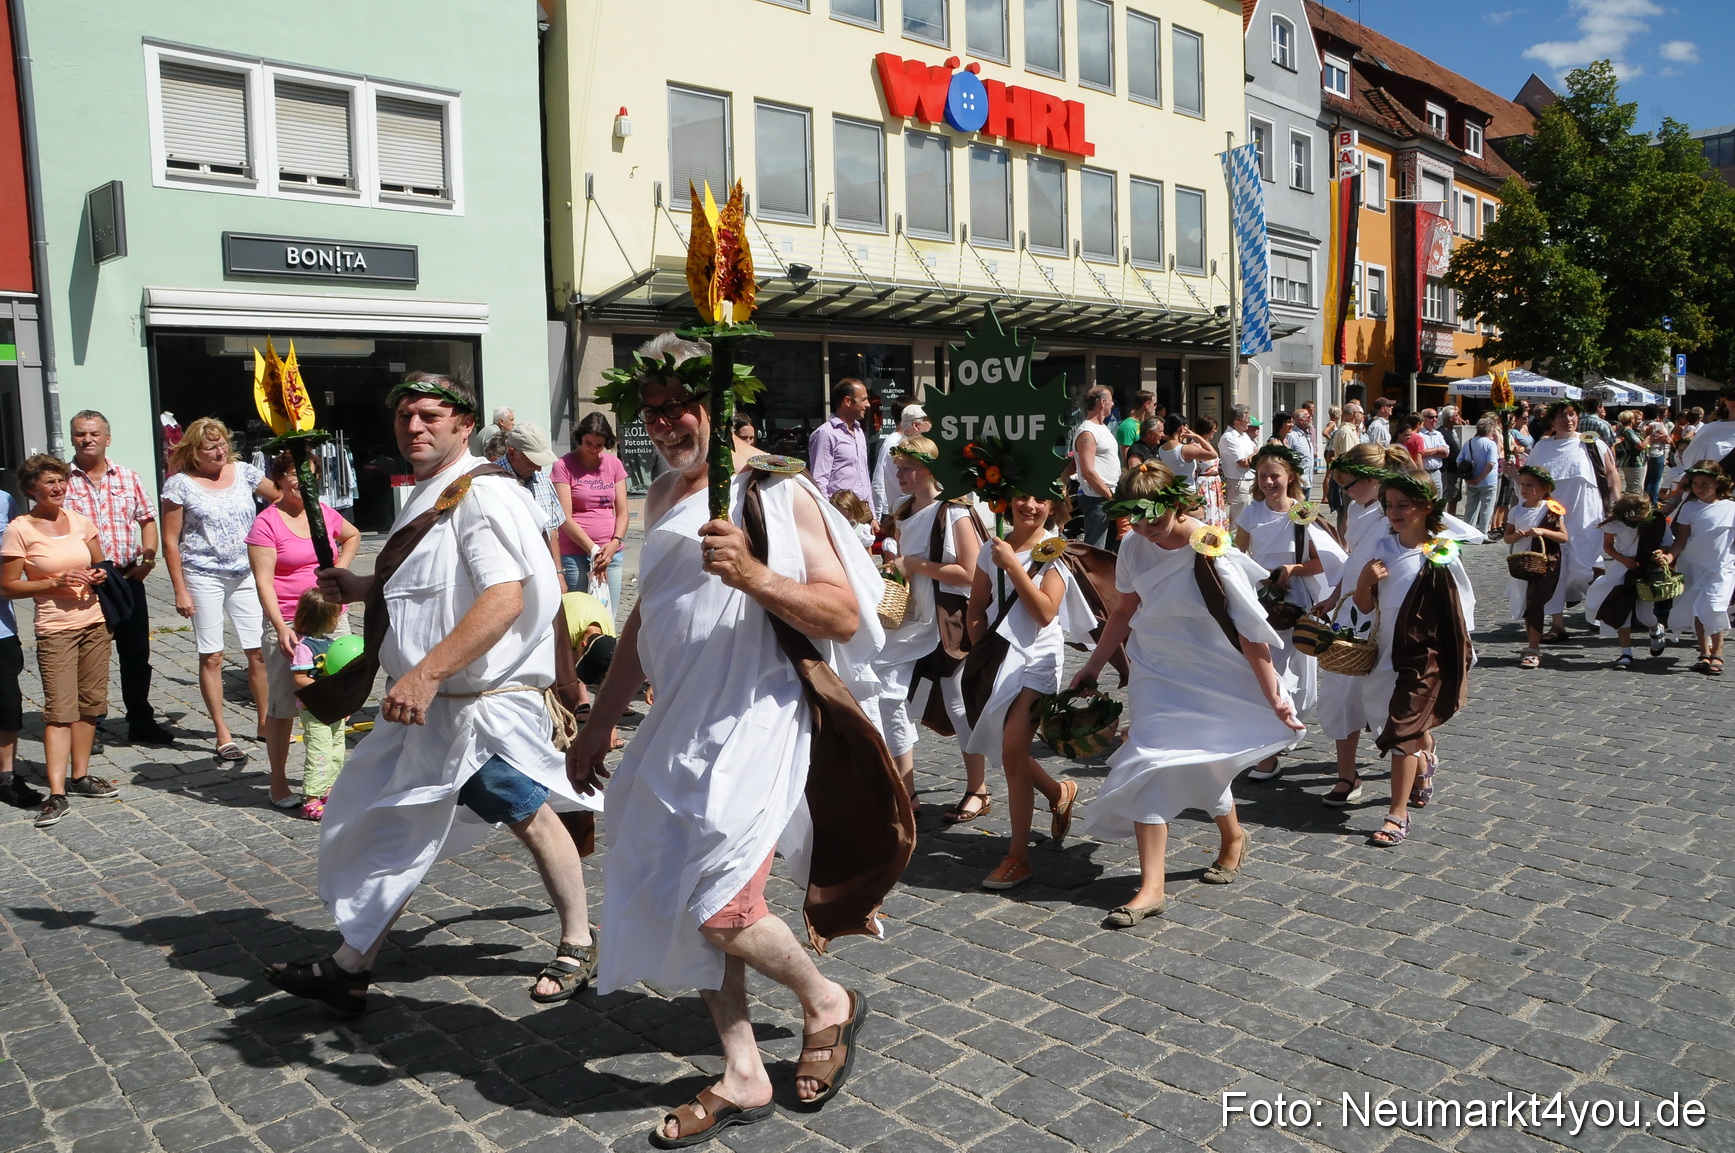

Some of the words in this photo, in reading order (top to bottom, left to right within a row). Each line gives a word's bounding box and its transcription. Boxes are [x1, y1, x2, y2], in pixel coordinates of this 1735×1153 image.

[875, 52, 1095, 157] WÖHRL
[958, 356, 1025, 386] OGV
[941, 414, 1046, 441] STAUF
